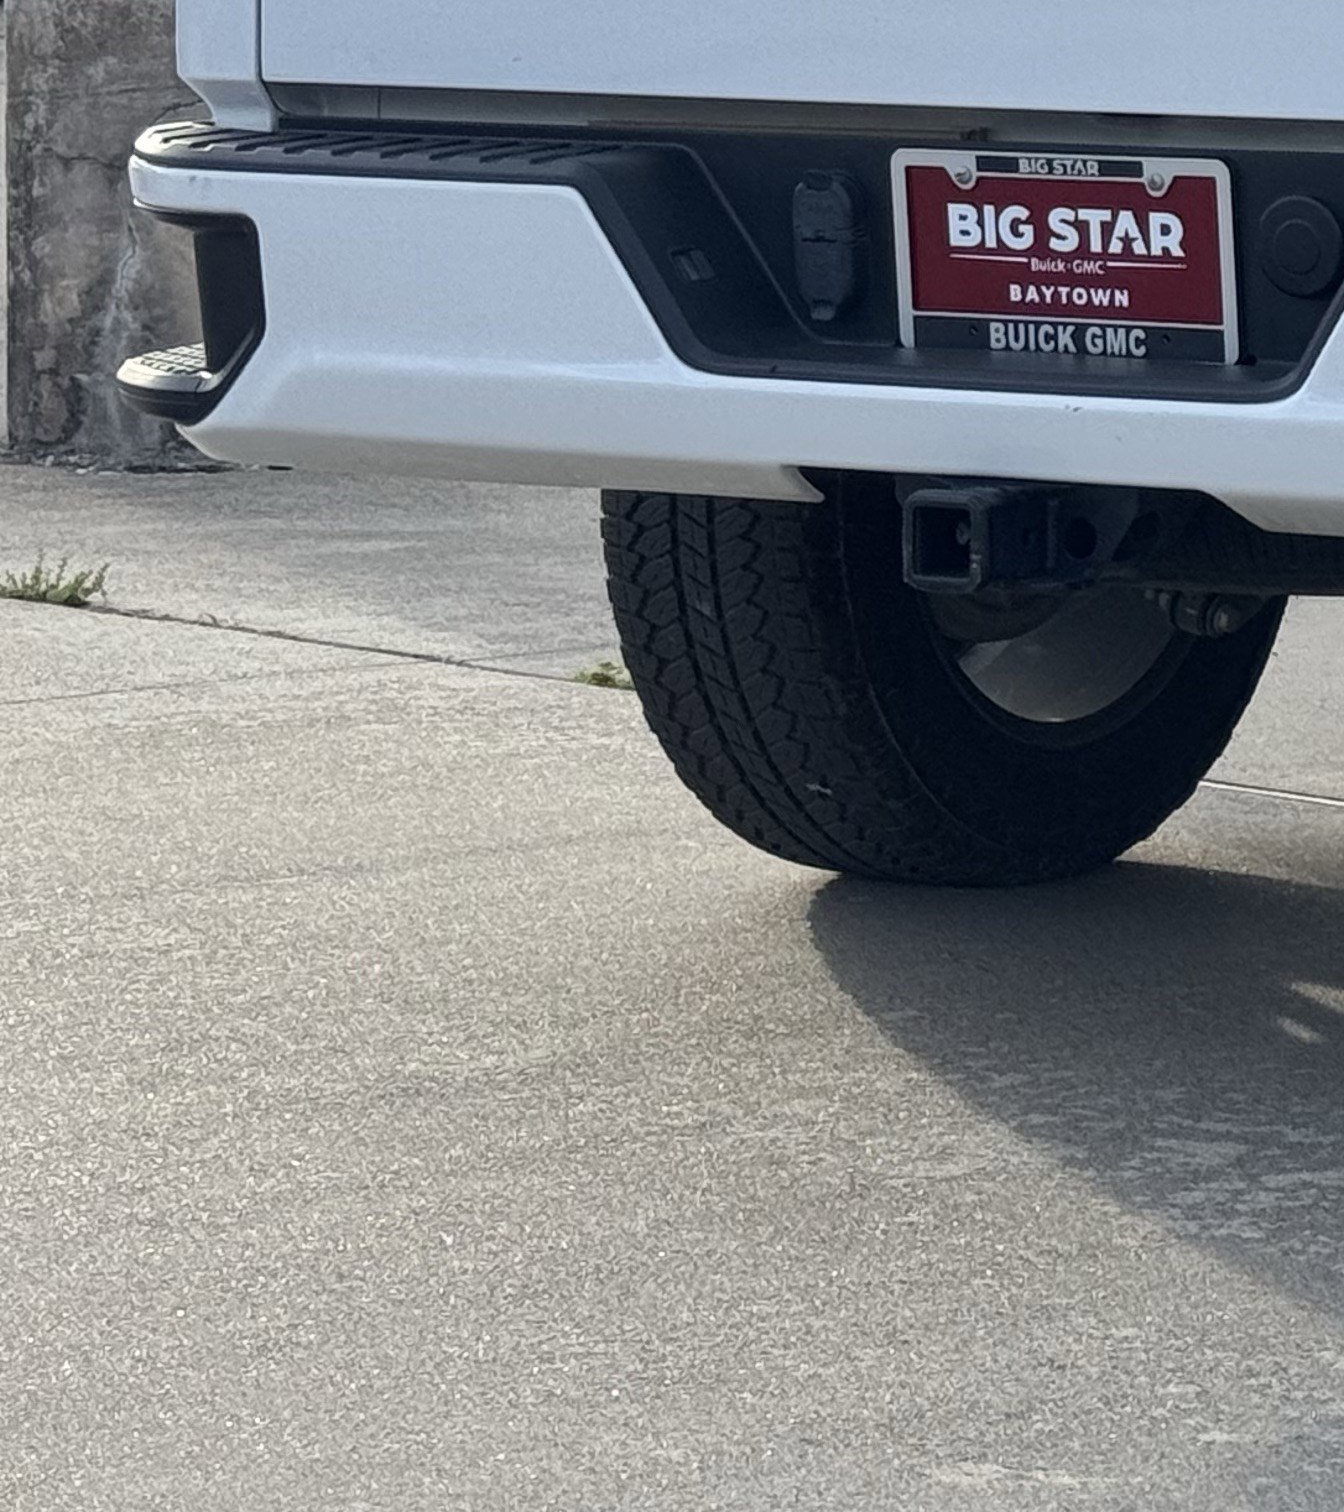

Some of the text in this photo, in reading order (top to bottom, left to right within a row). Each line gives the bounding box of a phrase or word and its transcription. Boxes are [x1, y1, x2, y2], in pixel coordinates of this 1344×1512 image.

[1018, 159, 1099, 177] BIG STAR
[946, 202, 1186, 257] BIG STAR
[1009, 284, 1130, 308] BAYTOWN
[989, 321, 1147, 357] BUICK GMC
